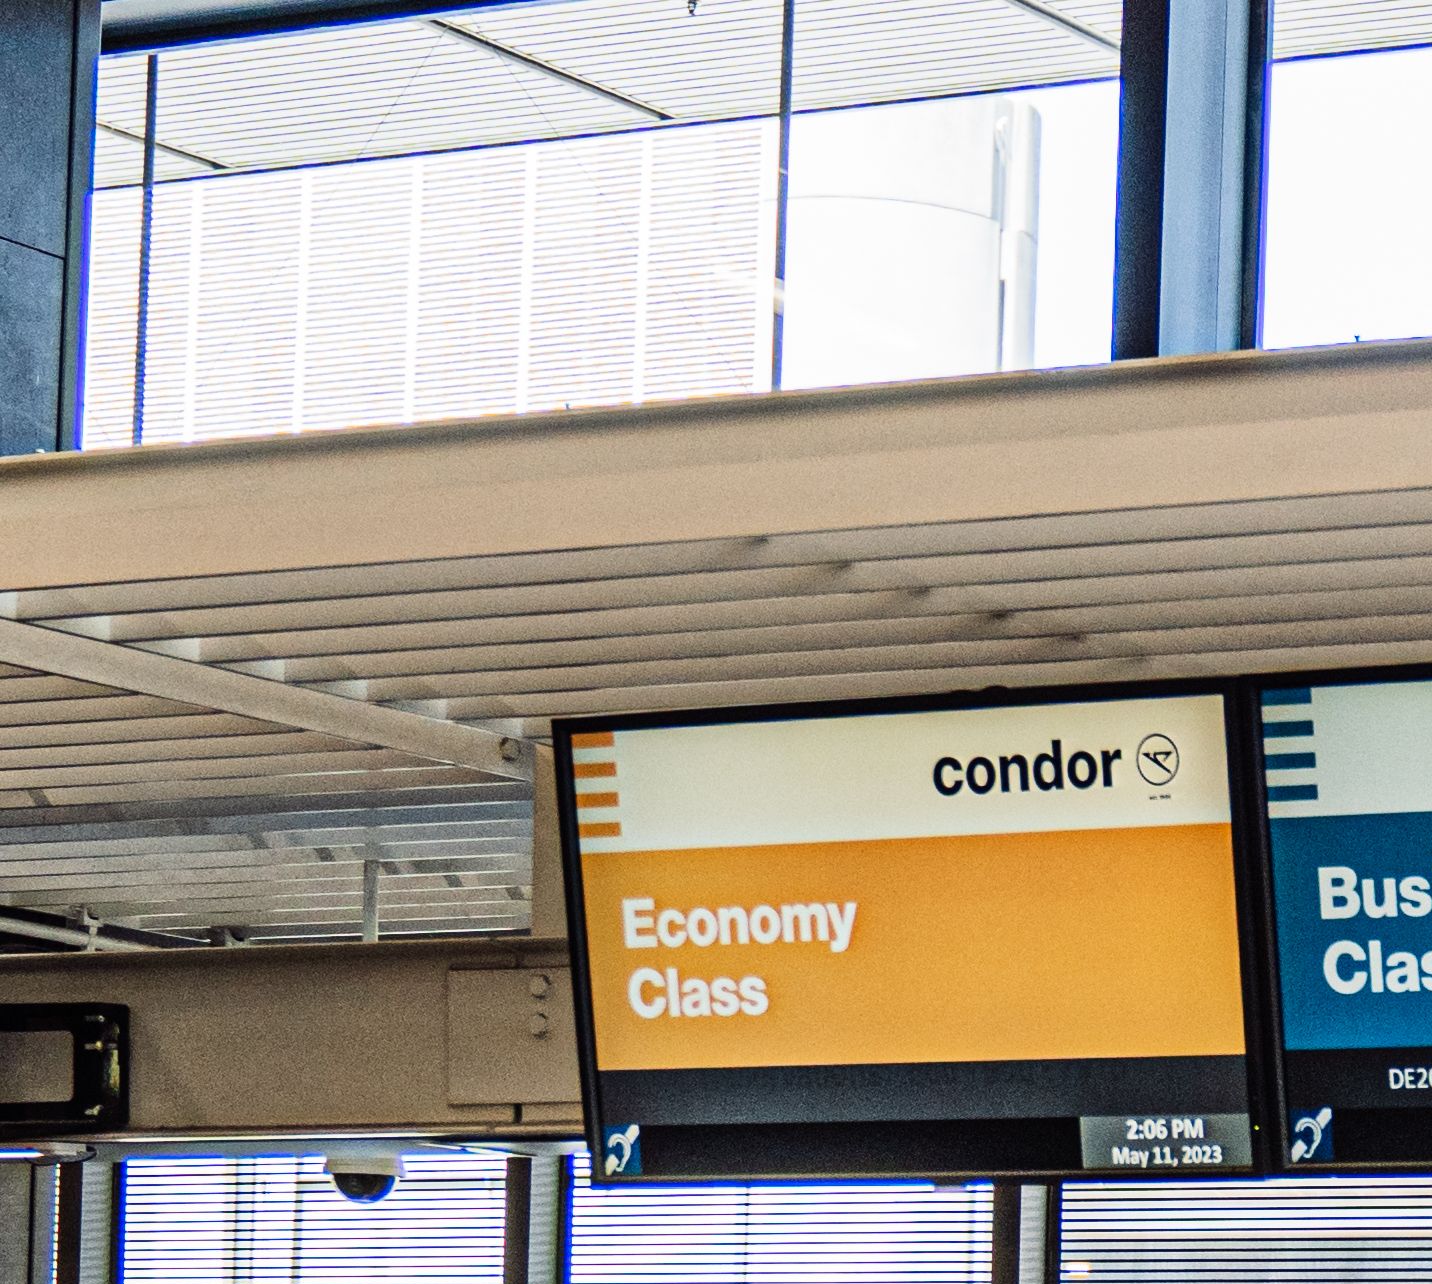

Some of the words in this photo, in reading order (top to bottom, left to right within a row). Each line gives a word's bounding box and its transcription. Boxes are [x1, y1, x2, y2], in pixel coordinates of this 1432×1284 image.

[933, 740, 1121, 796] condor
[623, 898, 856, 954] Economy
[629, 968, 768, 1018] Class
[1125, 1117, 1168, 1140] 2:06
[1171, 1117, 1204, 1139] PM
[1111, 1146, 1149, 1168] May
[1152, 1145, 1179, 1167] 11,
[1181, 1144, 1223, 1164] 2023
